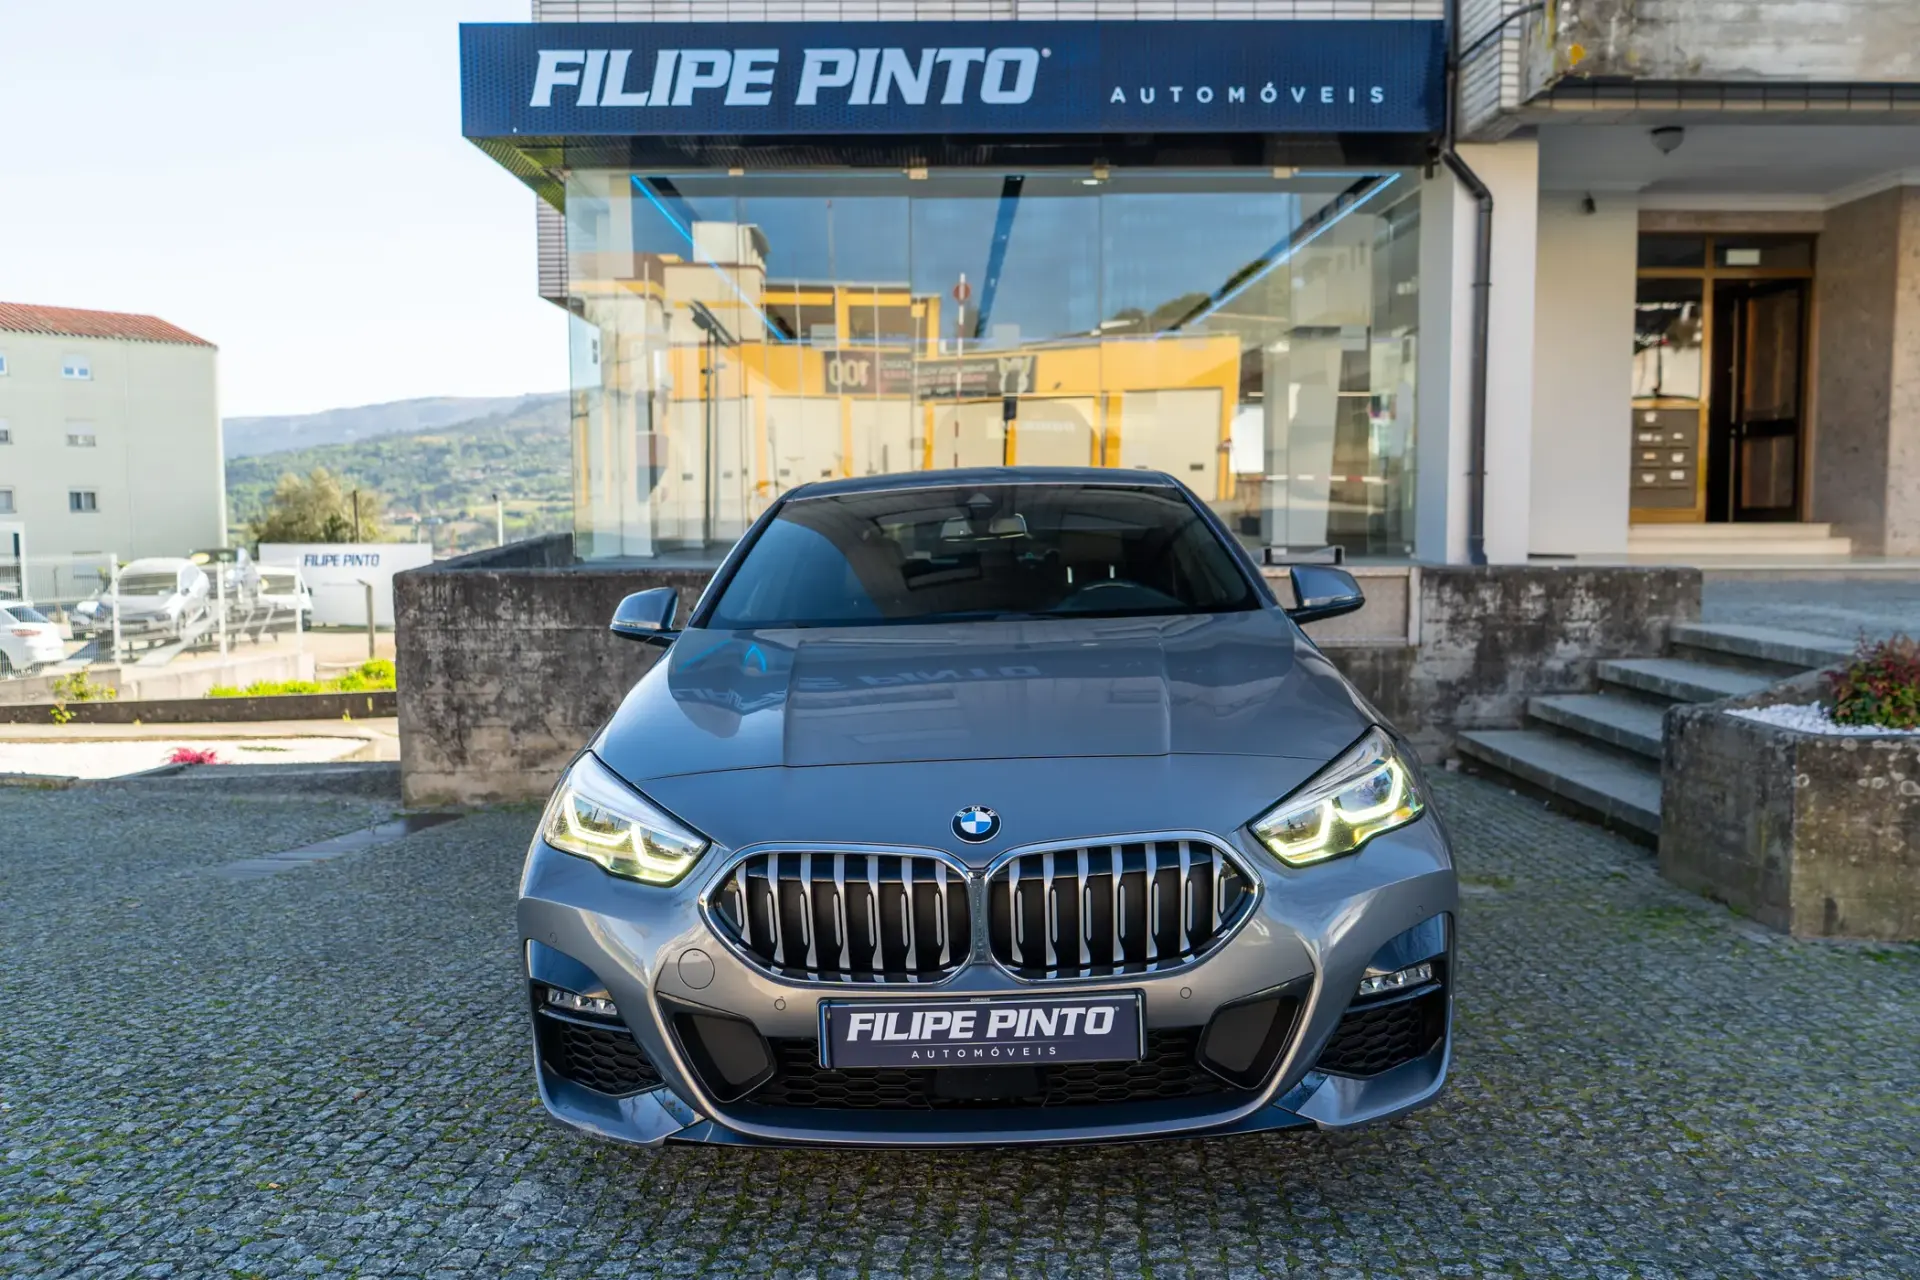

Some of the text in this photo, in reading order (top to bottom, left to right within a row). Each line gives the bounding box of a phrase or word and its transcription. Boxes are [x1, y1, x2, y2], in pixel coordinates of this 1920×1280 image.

[530, 47, 1040, 107] FILIPE PINTO
[1110, 82, 1384, 103] AUTOMÓVEIS
[304, 553, 380, 567] FILIPE PINTO
[846, 1006, 1115, 1041] FILIPE PINTO
[911, 1046, 1057, 1059] AUTOMÓVEIS
